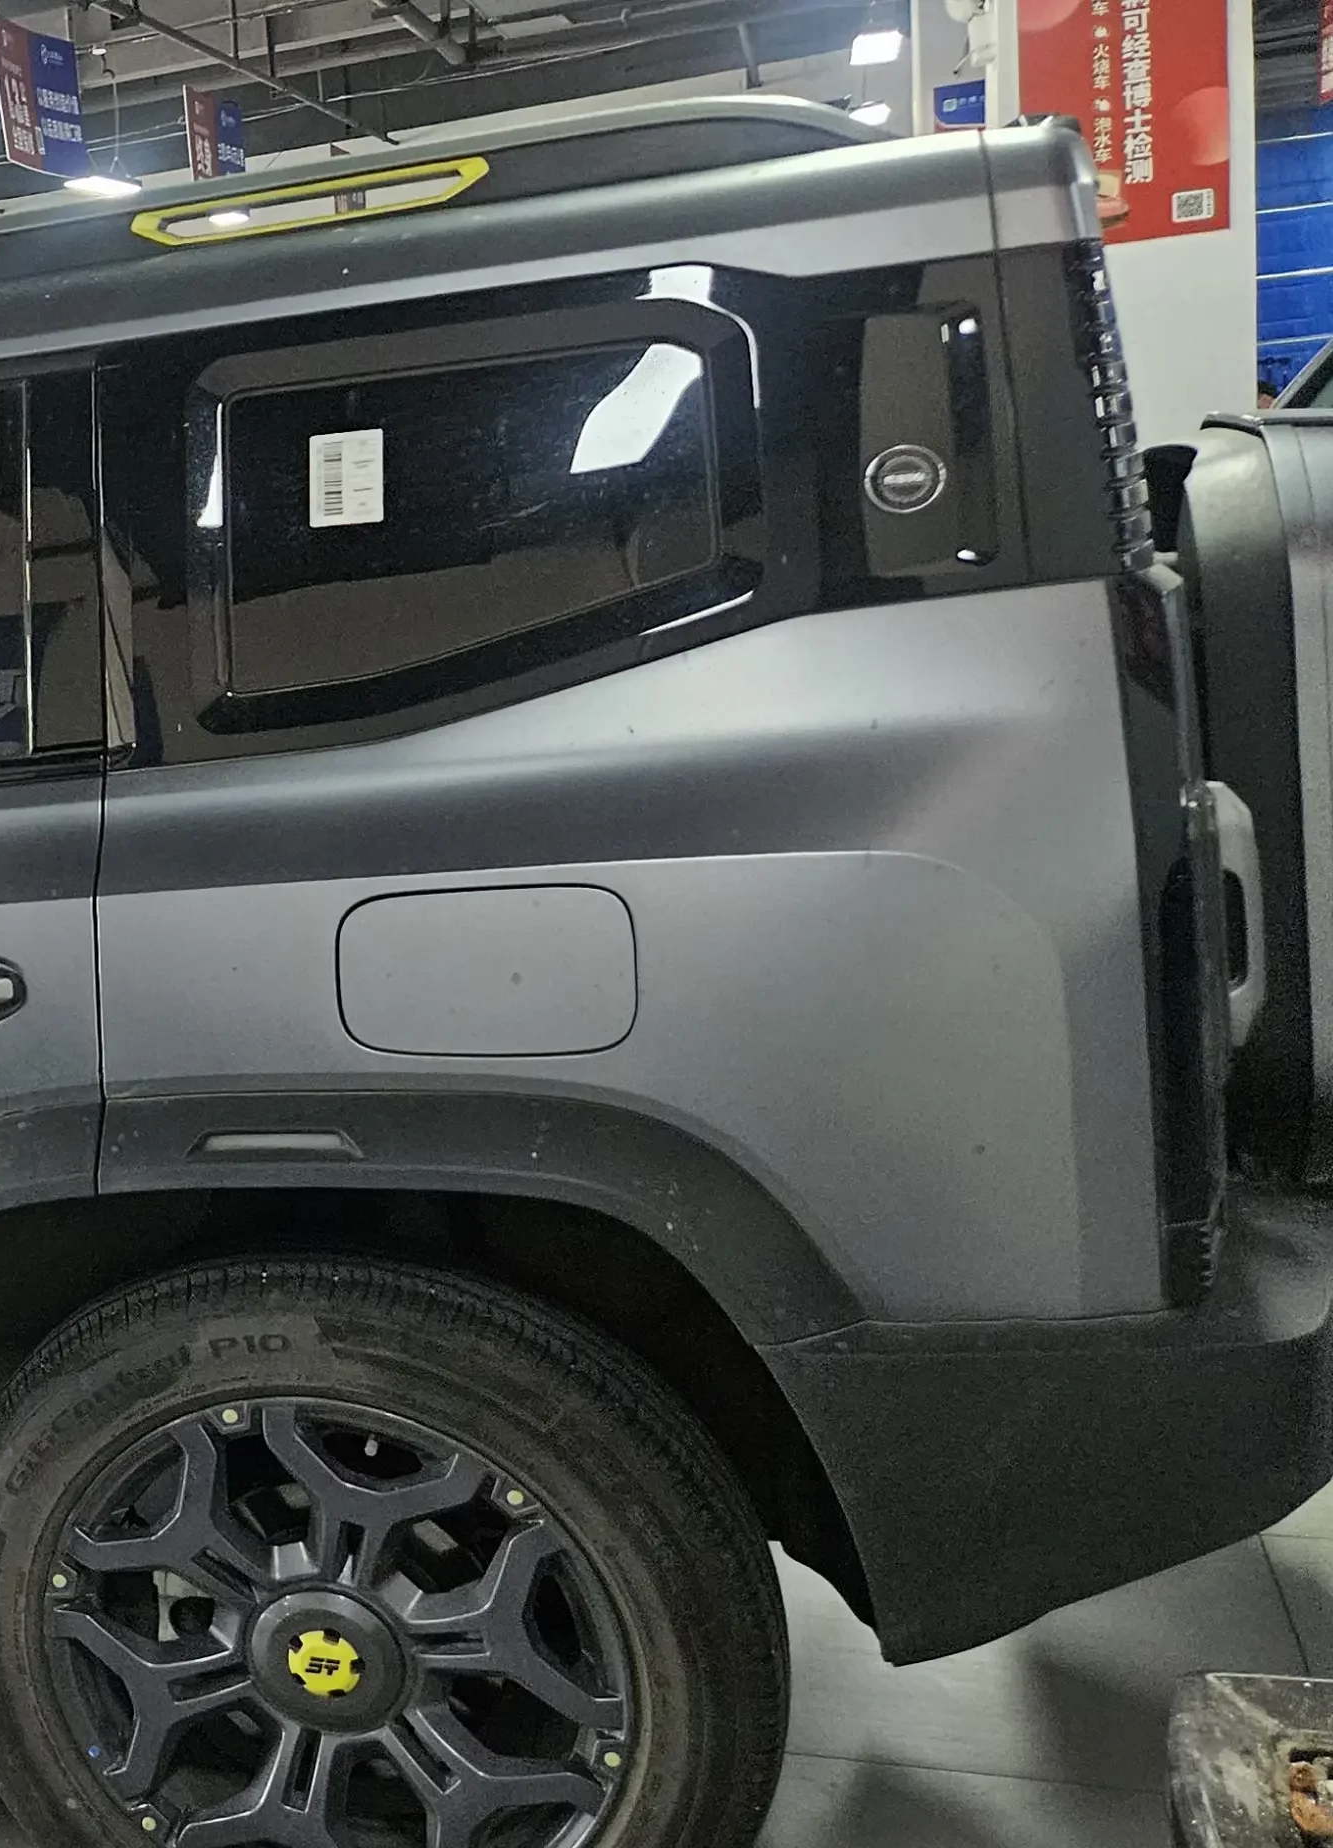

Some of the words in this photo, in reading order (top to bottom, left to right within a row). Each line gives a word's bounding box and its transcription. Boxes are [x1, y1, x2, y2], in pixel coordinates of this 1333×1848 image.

[1093, 44, 1111, 89] 火烧车
[1093, 117, 1112, 163] 泡水车
[208, 1332, 291, 1360] P10
